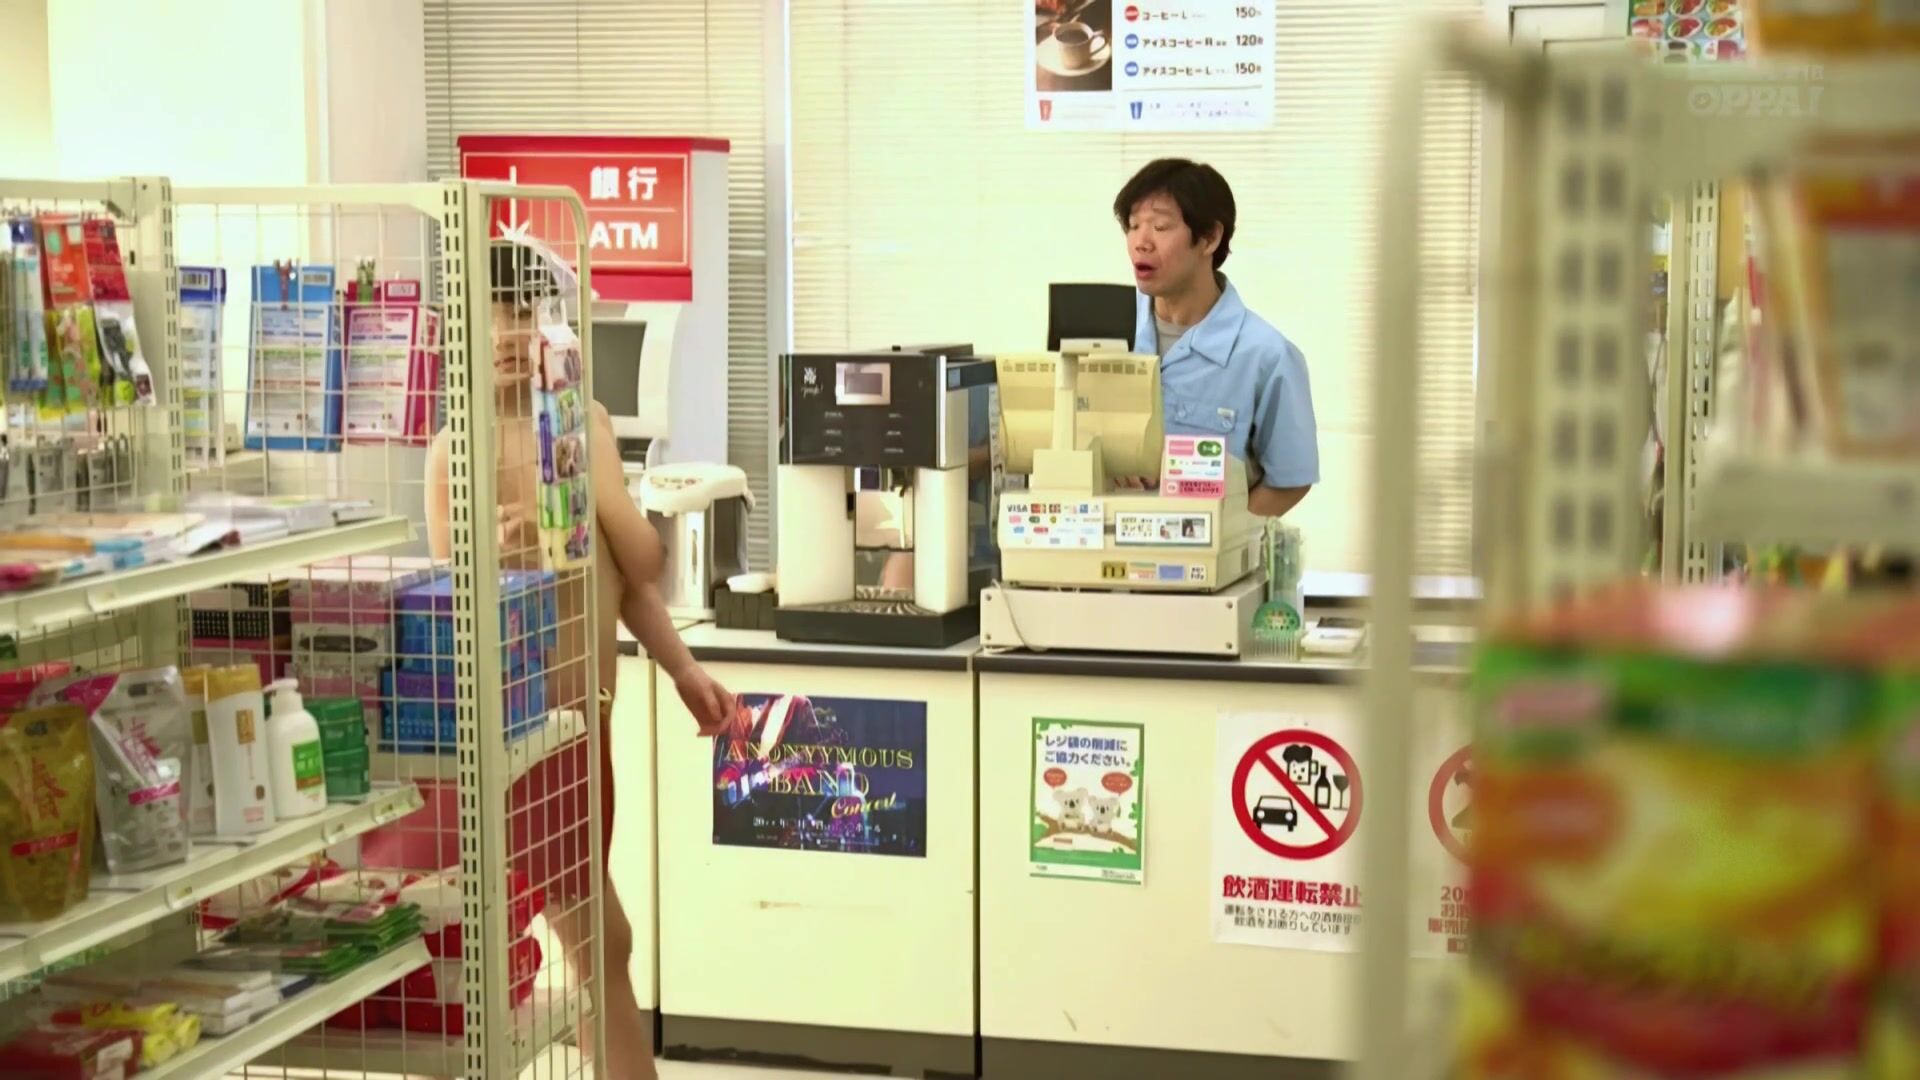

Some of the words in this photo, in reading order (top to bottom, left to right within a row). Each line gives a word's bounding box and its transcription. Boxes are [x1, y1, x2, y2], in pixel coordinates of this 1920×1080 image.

[1142, 11, 1179, 20] コーヒー
[1142, 38, 1202, 47] アイスコーヒー
[1142, 66, 1202, 75] アイスコーヒー
[589, 166, 658, 200] 銀行
[589, 221, 658, 250] ATM
[1007, 504, 1028, 513] VISA
[1045, 735, 1128, 751] レジ袋の削減に
[1044, 751, 1131, 767] ご協力ください。
[767, 769, 870, 796] BAND
[830, 792, 897, 818] Concert
[1222, 874, 1363, 908] 飲酒運転禁止
